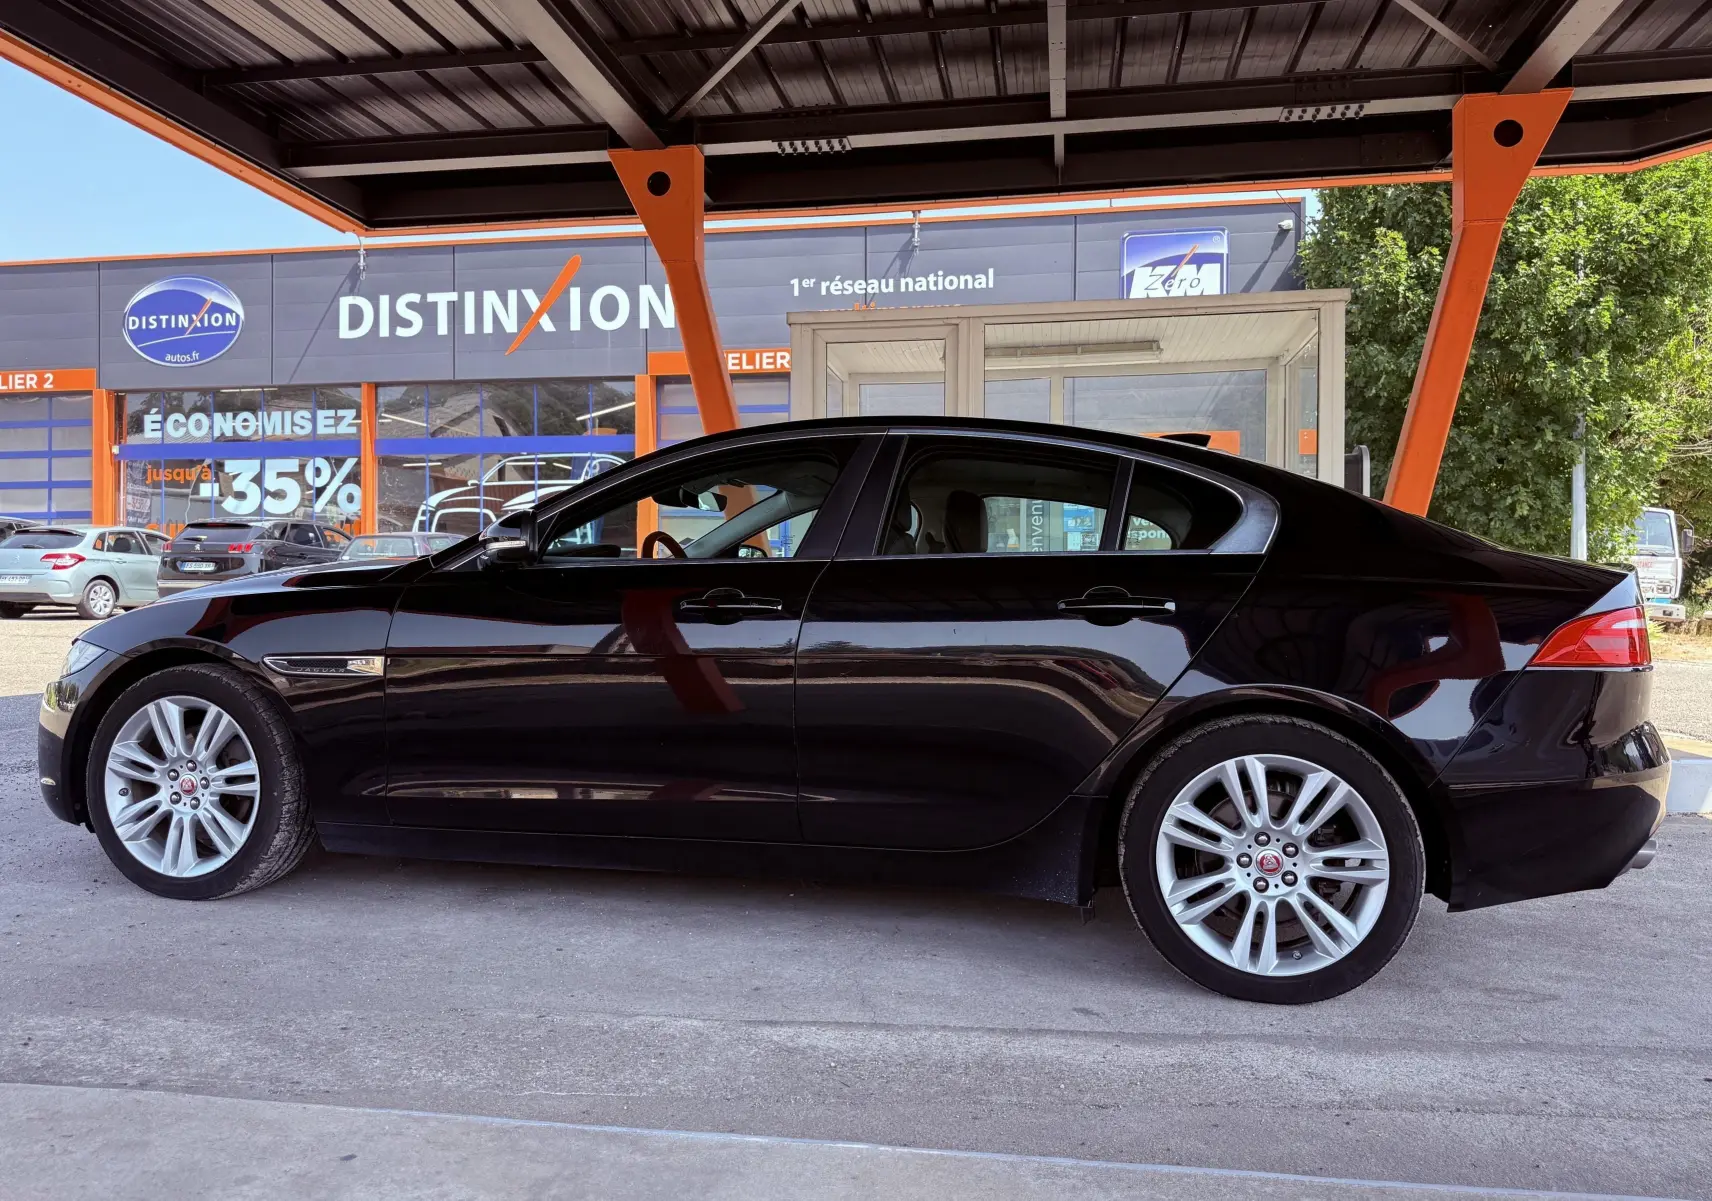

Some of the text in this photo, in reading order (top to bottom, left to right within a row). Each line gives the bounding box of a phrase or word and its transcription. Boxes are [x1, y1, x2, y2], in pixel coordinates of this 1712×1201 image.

[790, 268, 994, 296] 1er réseau national
[1143, 273, 1201, 291] Zero
[339, 257, 676, 345] DISTINXION
[128, 303, 237, 334] DISTINXION
[165, 351, 200, 363] autos.fr
[724, 351, 791, 370] ELIER
[43, 372, 54, 389] 2
[143, 407, 357, 438] ÉCONOMISEZ
[199, 456, 362, 515] -35%
